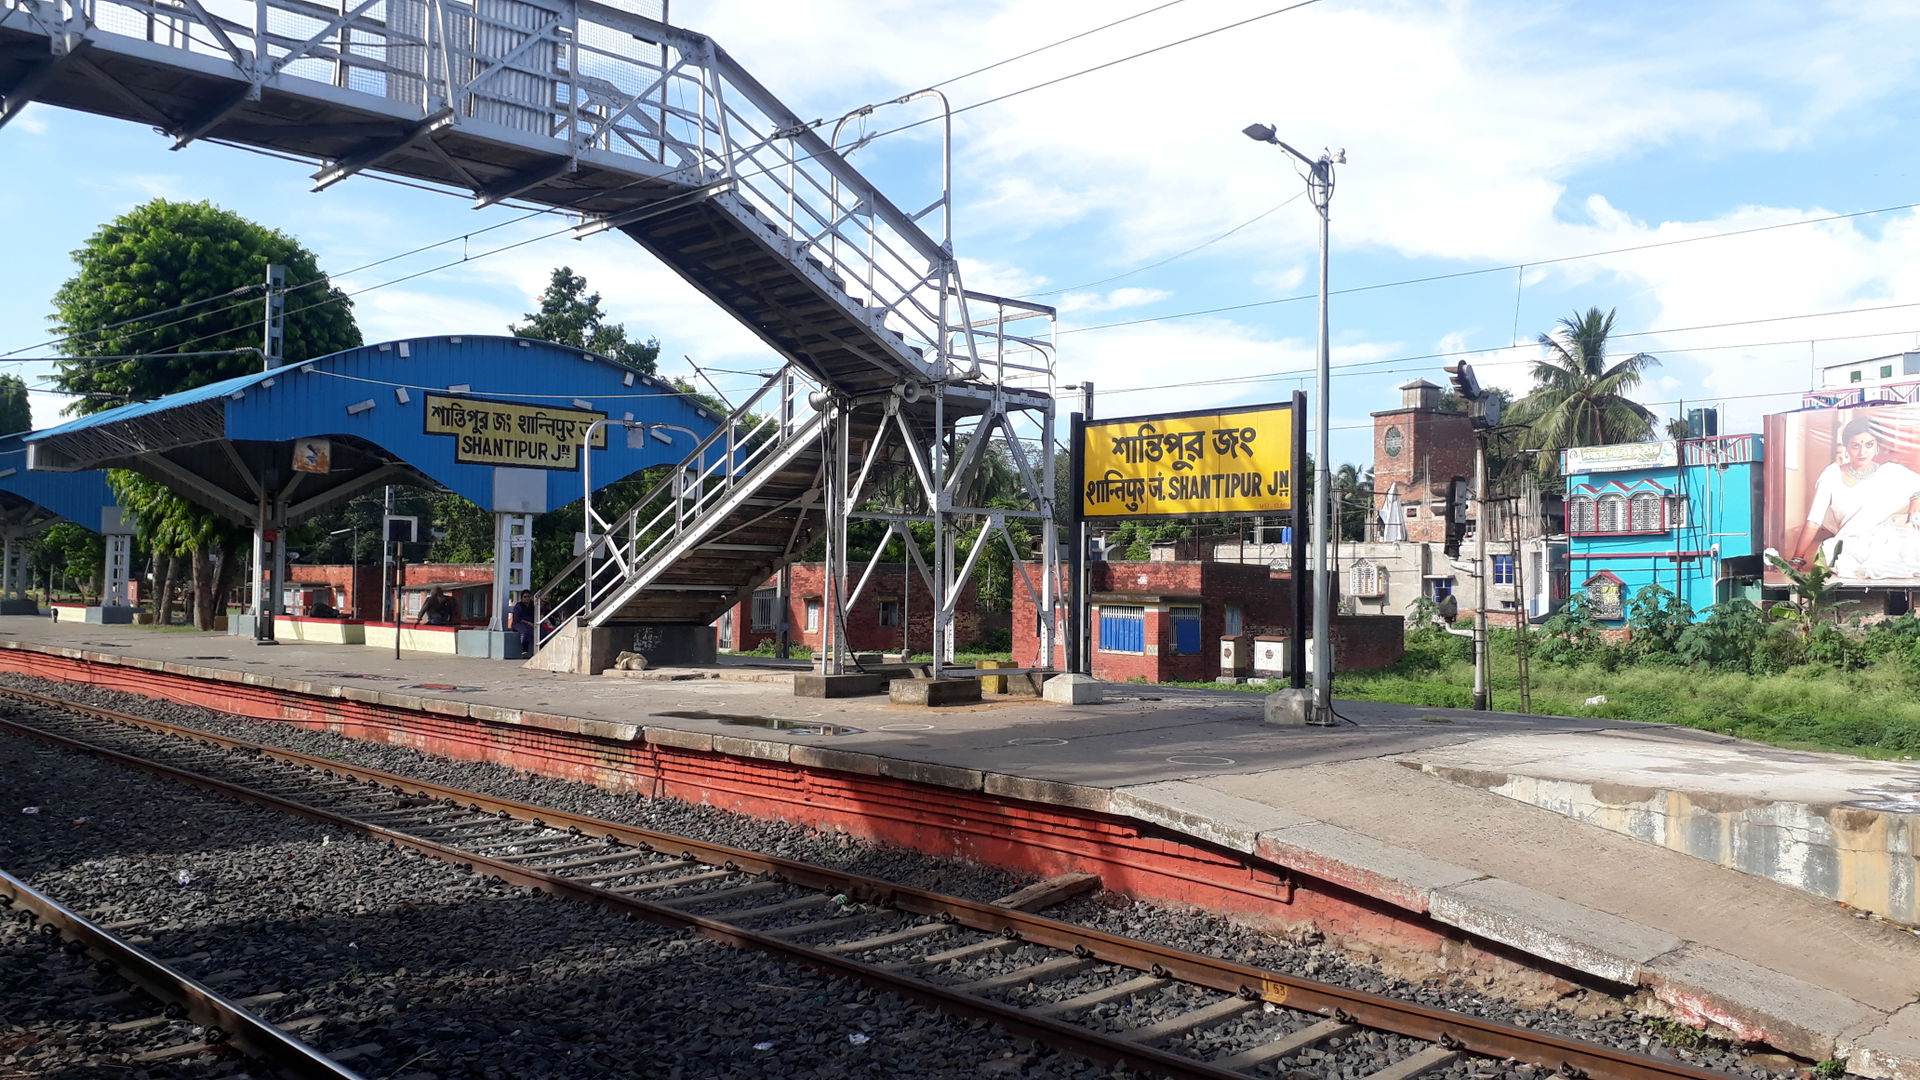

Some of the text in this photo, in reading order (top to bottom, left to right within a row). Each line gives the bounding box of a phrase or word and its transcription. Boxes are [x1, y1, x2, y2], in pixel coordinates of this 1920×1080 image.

[493, 412, 512, 433] জং
[461, 435, 548, 460] SHANTIPUR
[1111, 423, 1256, 471] শান্তিপুর জং
[1086, 469, 1145, 512] शान्तिपुर
[1168, 472, 1262, 501] SHANTIPUR
